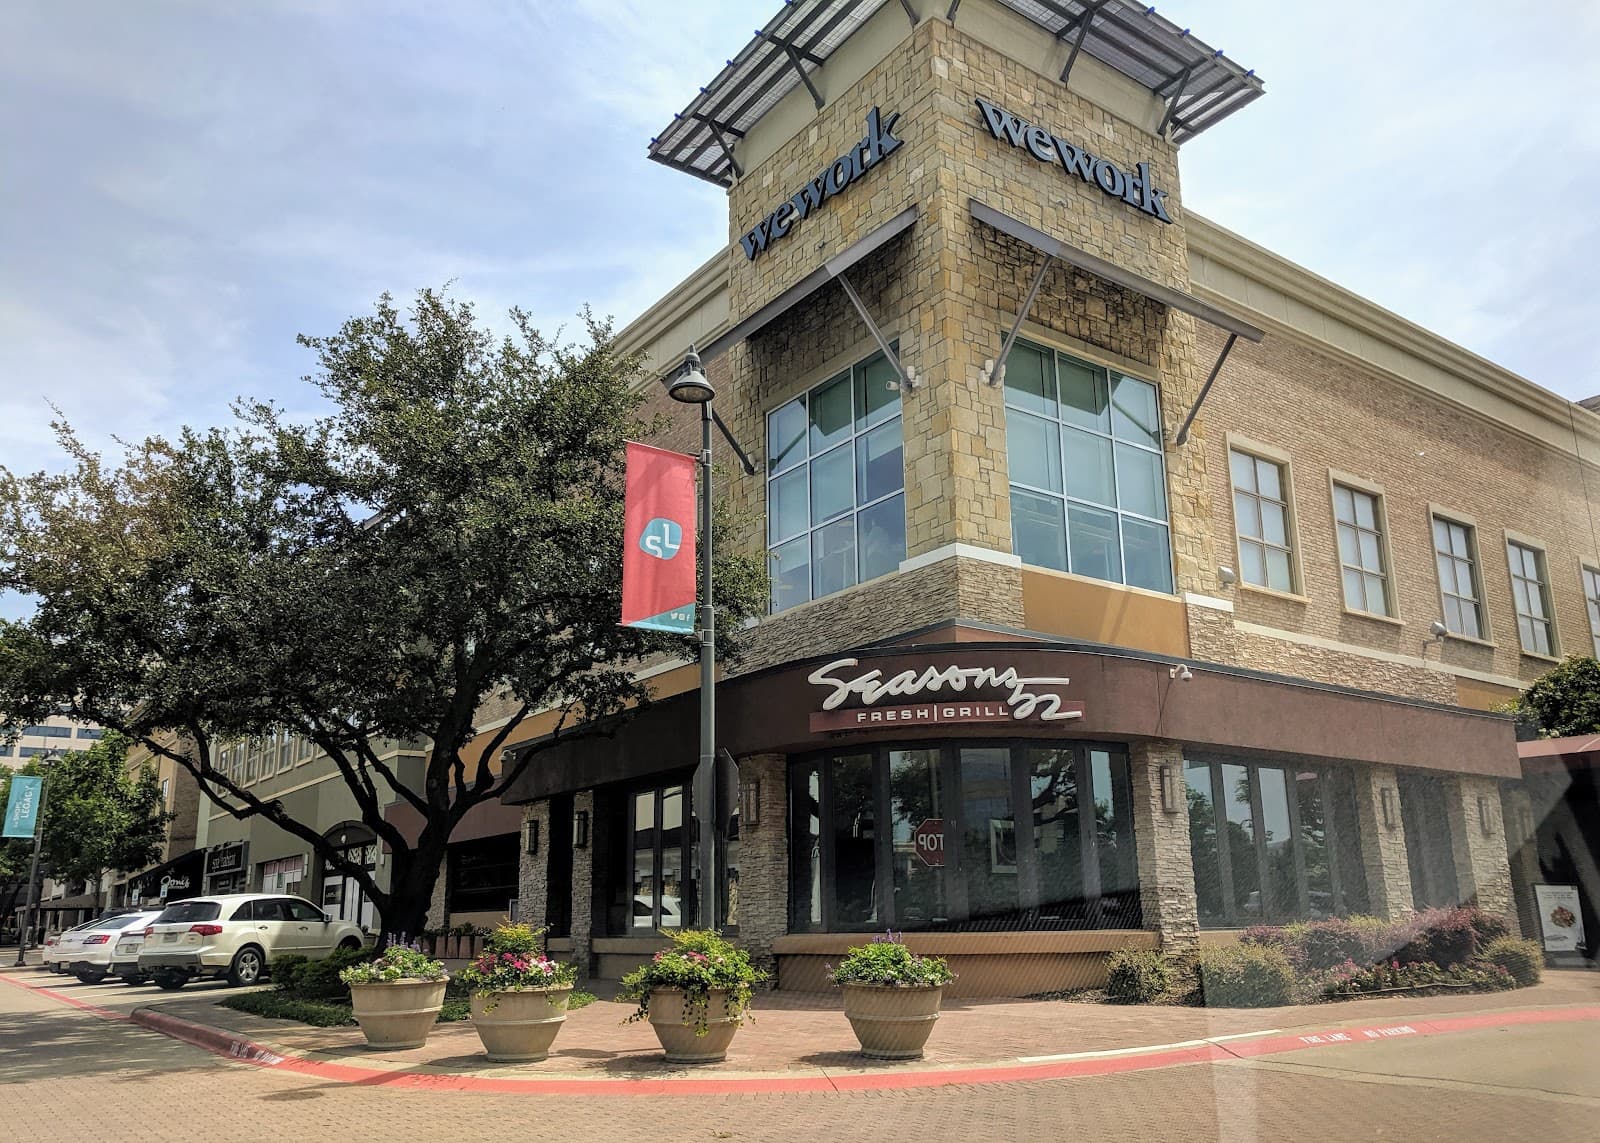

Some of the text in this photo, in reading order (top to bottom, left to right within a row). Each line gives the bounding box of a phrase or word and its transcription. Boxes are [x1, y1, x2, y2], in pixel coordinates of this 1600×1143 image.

[738, 105, 904, 260] wework
[976, 98, 1172, 225] wework
[808, 657, 1083, 720] Seasons 52
[857, 705, 1009, 723] FRESH GRILL
